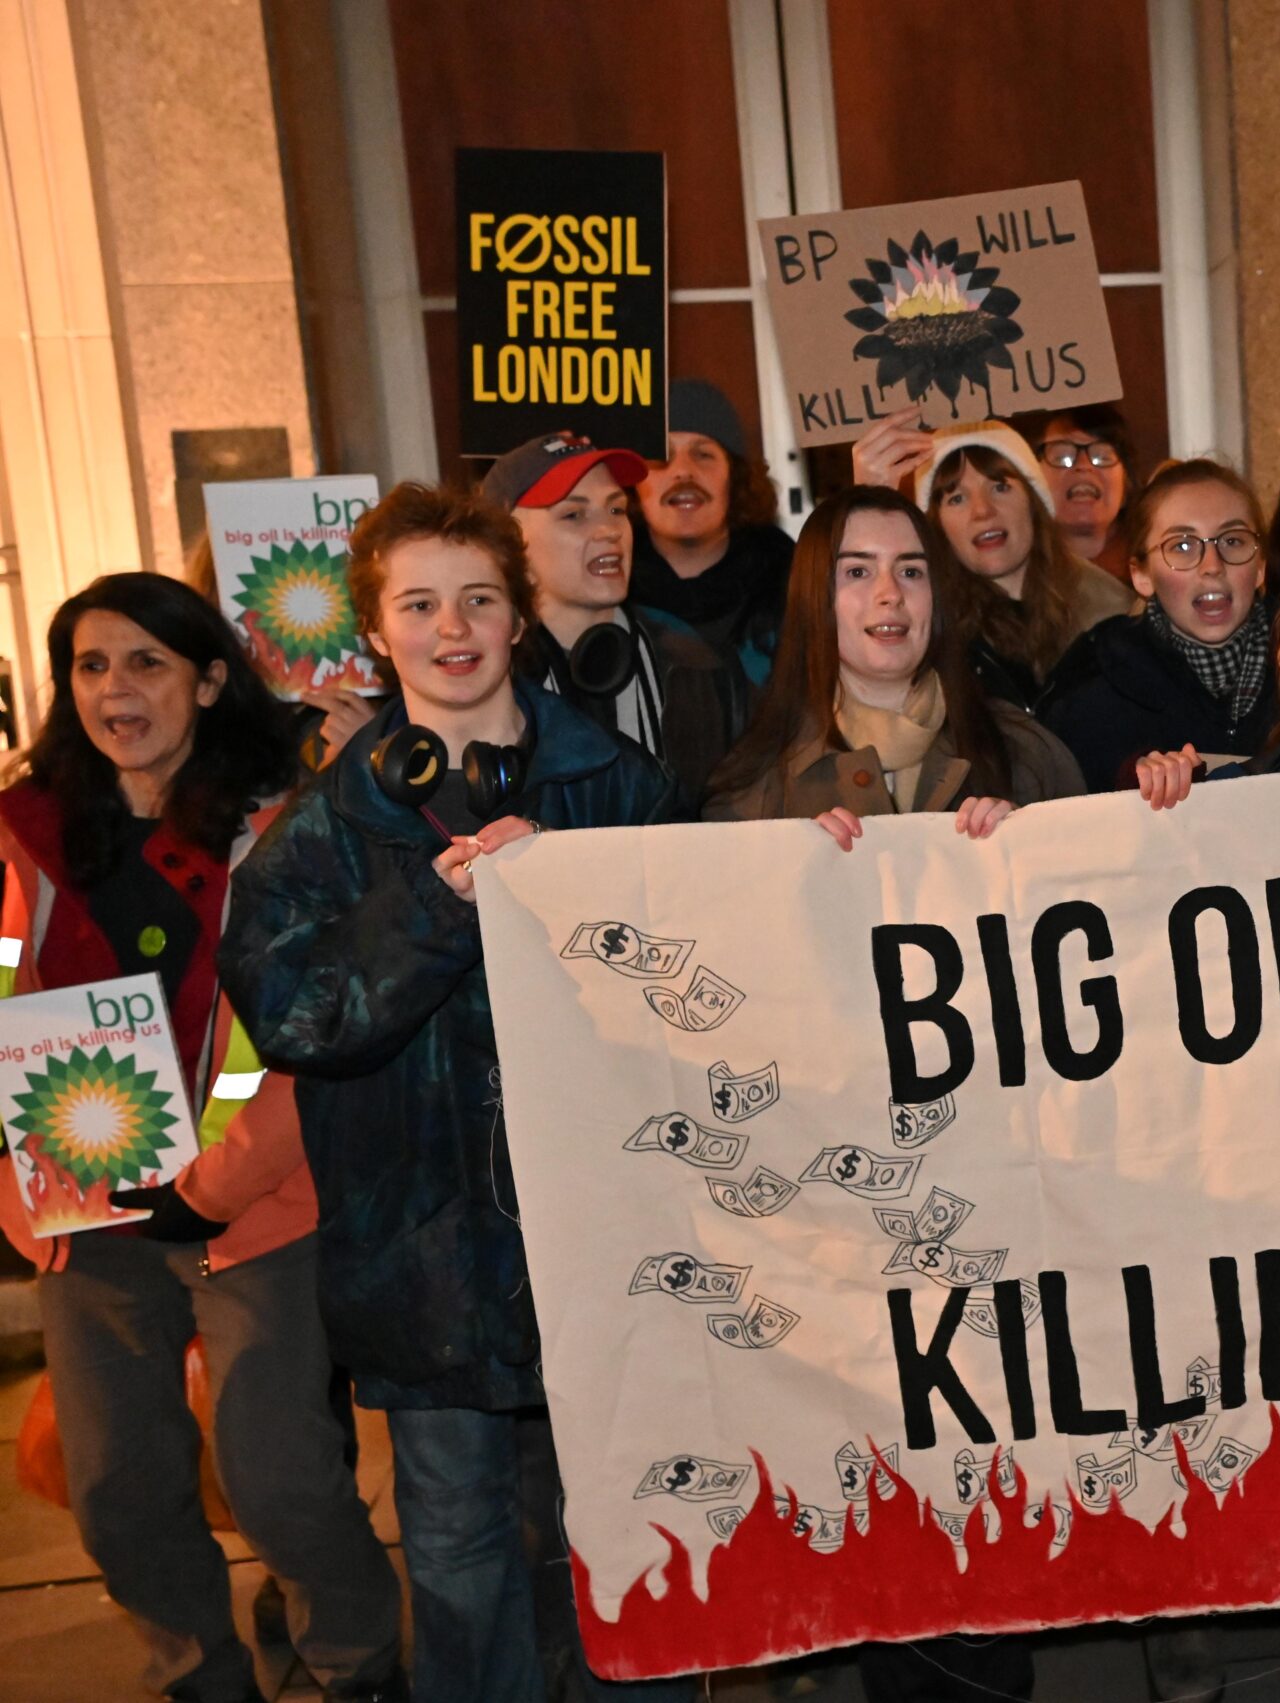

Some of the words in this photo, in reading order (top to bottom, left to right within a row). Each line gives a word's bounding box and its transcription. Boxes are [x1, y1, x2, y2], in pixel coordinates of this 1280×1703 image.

[774, 229, 838, 285] BP
[976, 206, 1076, 254] WILL
[507, 280, 617, 340] FREE
[472, 344, 651, 406] LONDON
[798, 384, 890, 433] KILL
[1025, 341, 1086, 393] US
[224, 530, 253, 546] big
[258, 528, 279, 543] oil
[283, 528, 296, 542] is
[301, 527, 350, 543] killing
[313, 492, 369, 533] bp
[86, 990, 155, 1033] bp
[872, 900, 1125, 1104] BIG
[31, 1038, 54, 1056] oil
[58, 1036, 73, 1051] is
[77, 1027, 136, 1047] killing
[141, 1023, 162, 1037] us
